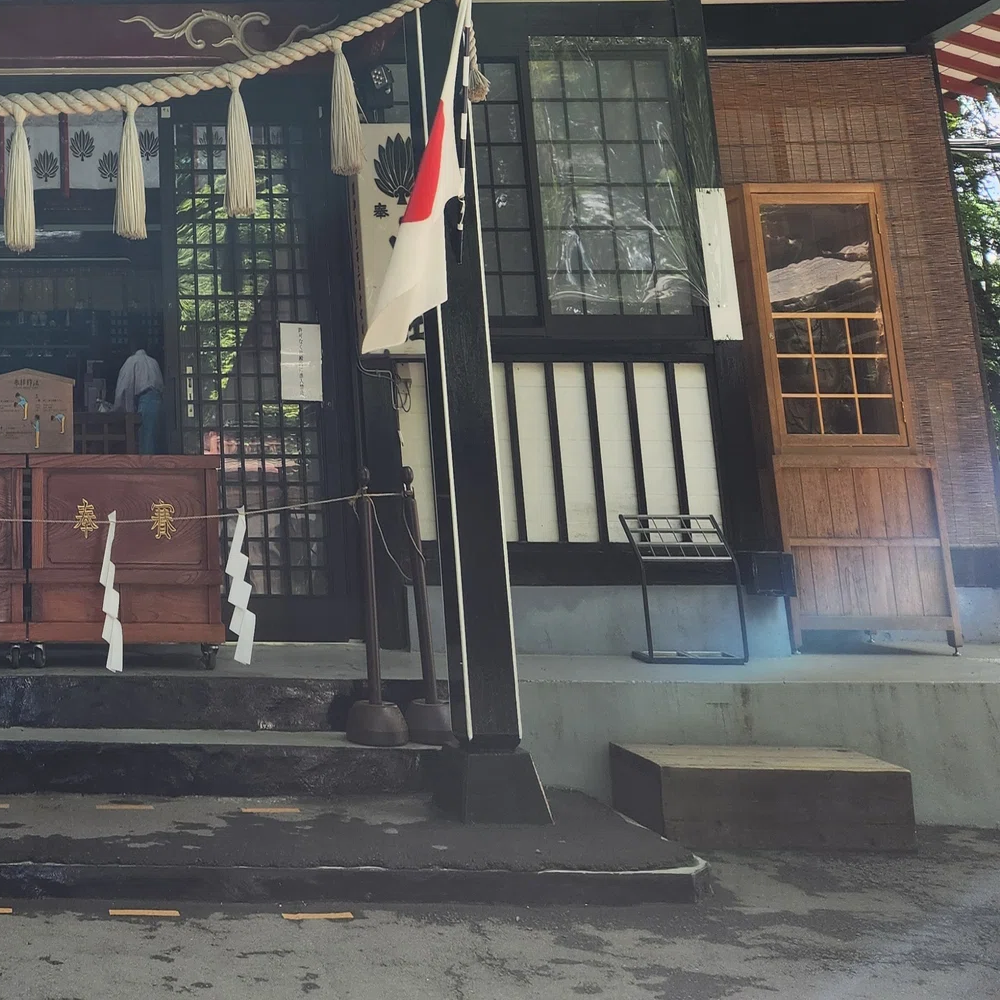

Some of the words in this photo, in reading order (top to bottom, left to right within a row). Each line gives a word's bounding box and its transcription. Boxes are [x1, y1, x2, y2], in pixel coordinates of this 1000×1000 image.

[373, 202, 389, 219] 奉
[73, 498, 99, 539] 奉
[150, 498, 177, 540] 賽
